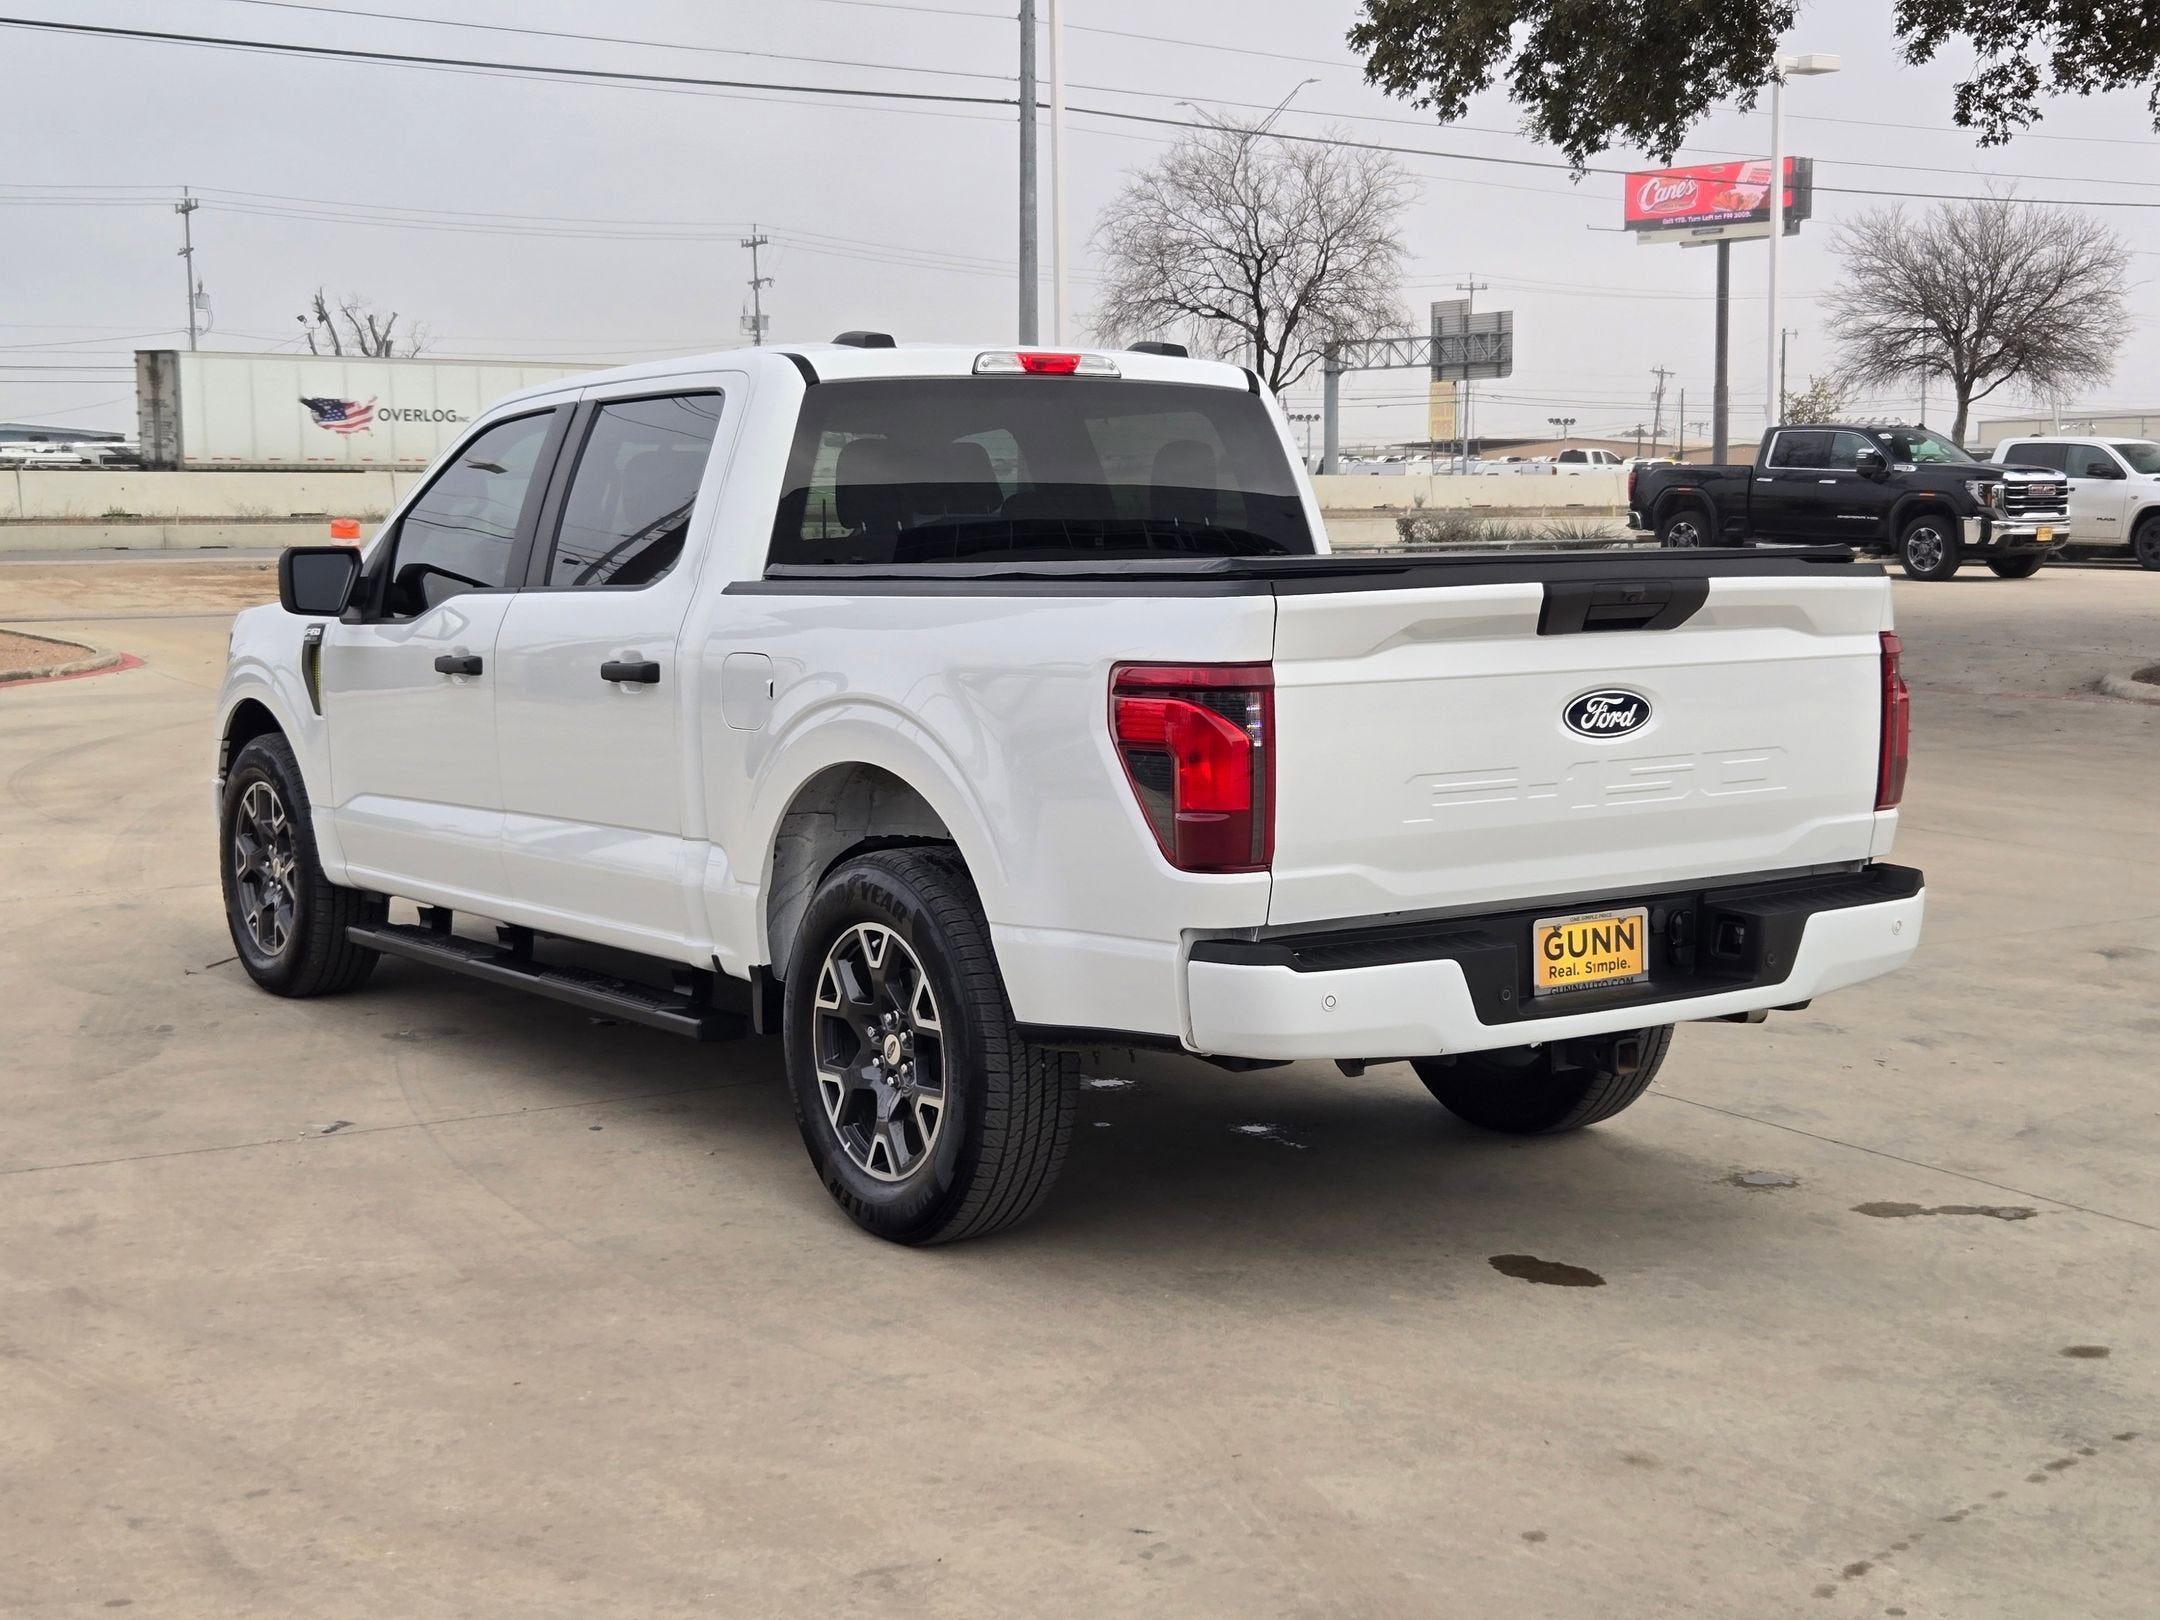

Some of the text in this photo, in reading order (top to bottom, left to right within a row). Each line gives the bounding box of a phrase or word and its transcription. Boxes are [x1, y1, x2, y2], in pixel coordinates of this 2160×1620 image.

[1640, 175, 1697, 211] Cane's
[378, 408, 457, 423] OVERLOG
[1580, 697, 1638, 730] Ford
[1543, 923, 1635, 961] GUNN
[1548, 963, 1580, 979] Real.
